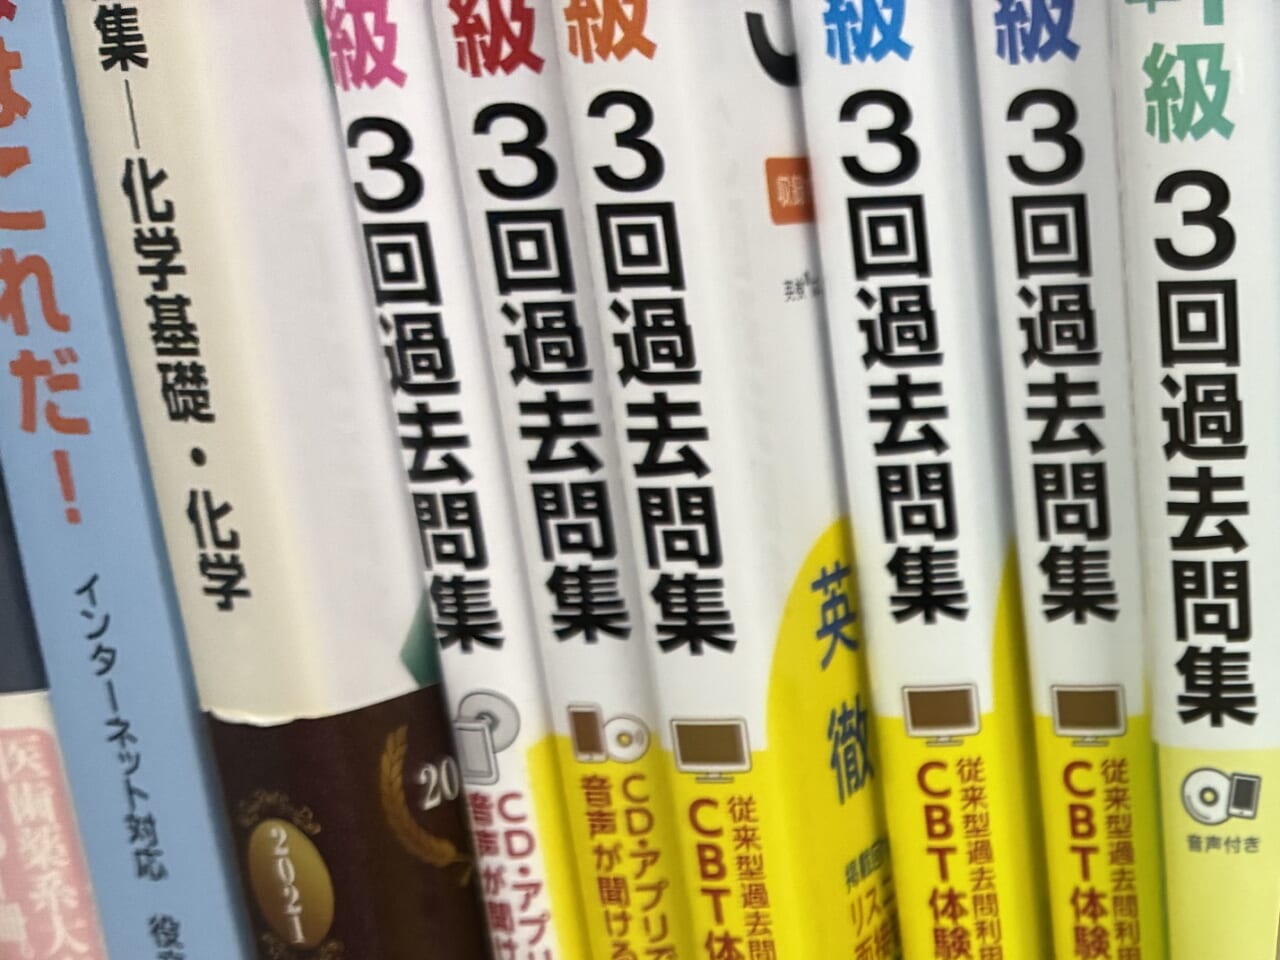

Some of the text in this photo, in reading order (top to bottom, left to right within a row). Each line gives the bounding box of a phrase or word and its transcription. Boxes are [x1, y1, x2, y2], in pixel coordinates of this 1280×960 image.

[75, 574, 168, 881] インターネット対応
[1186, 833, 1260, 854] 音声付き
